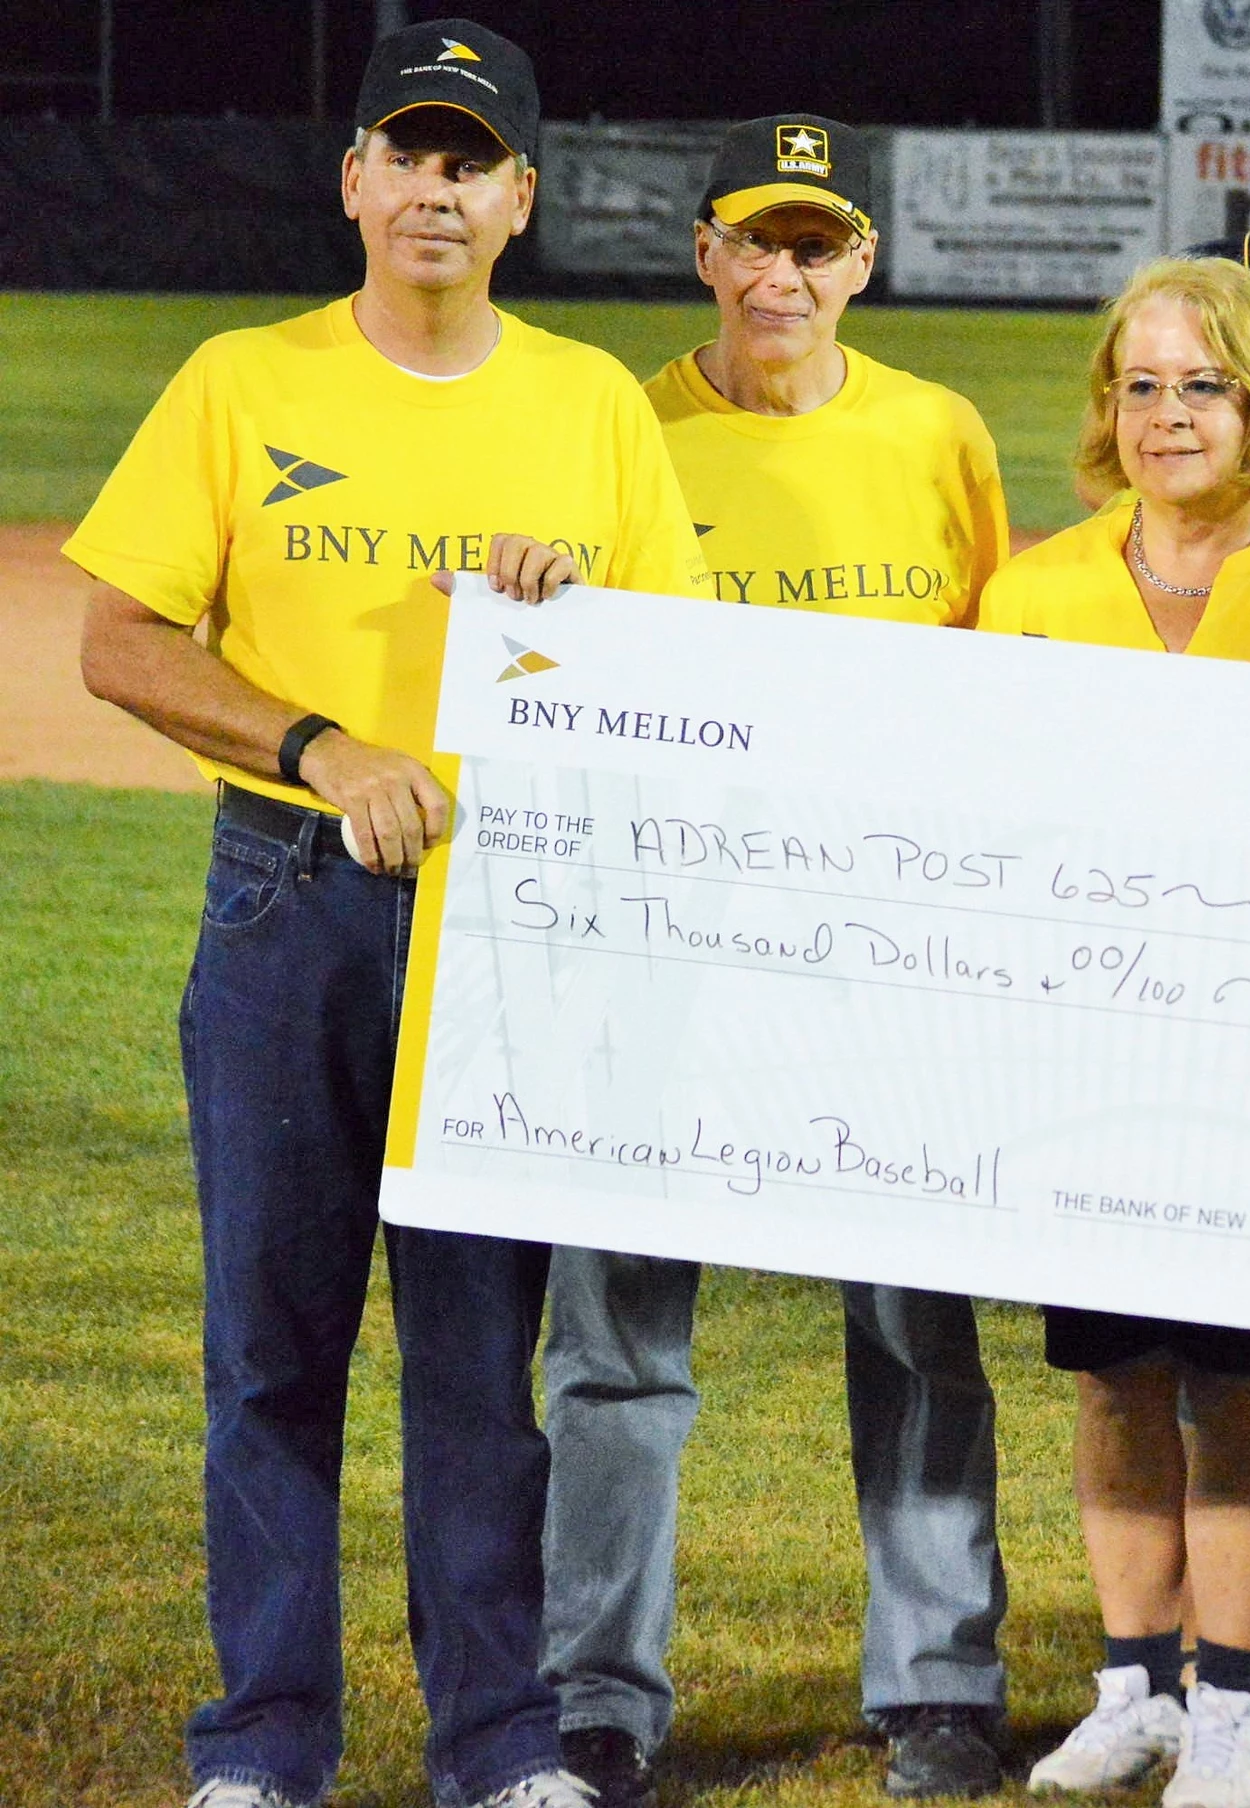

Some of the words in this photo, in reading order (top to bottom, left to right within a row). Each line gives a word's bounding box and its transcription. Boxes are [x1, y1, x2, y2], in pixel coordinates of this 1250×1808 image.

[284, 524, 388, 566] BNY
[508, 698, 584, 731] BNY
[595, 707, 754, 751] MELLON
[479, 805, 518, 827] PAY
[523, 810, 548, 830] TO
[555, 814, 596, 836] THE
[477, 829, 548, 855] ORDER
[554, 837, 582, 858] OF
[630, 817, 854, 874] ADREAN
[863, 833, 1022, 889] POST
[1051, 862, 1156, 908] 625
[511, 877, 606, 939] Six
[619, 896, 833, 964] Thousand
[844, 922, 1013, 988] Dollars
[442, 1117, 484, 1140] FOR
[493, 1091, 682, 1168] American
[692, 1117, 822, 1196] Legion
[808, 1114, 1002, 1206] Baseball
[1052, 1190, 1093, 1213] THE
[1099, 1195, 1158, 1221] BANK
[1163, 1202, 1192, 1224] OF
[1197, 1205, 1249, 1231] NEW
